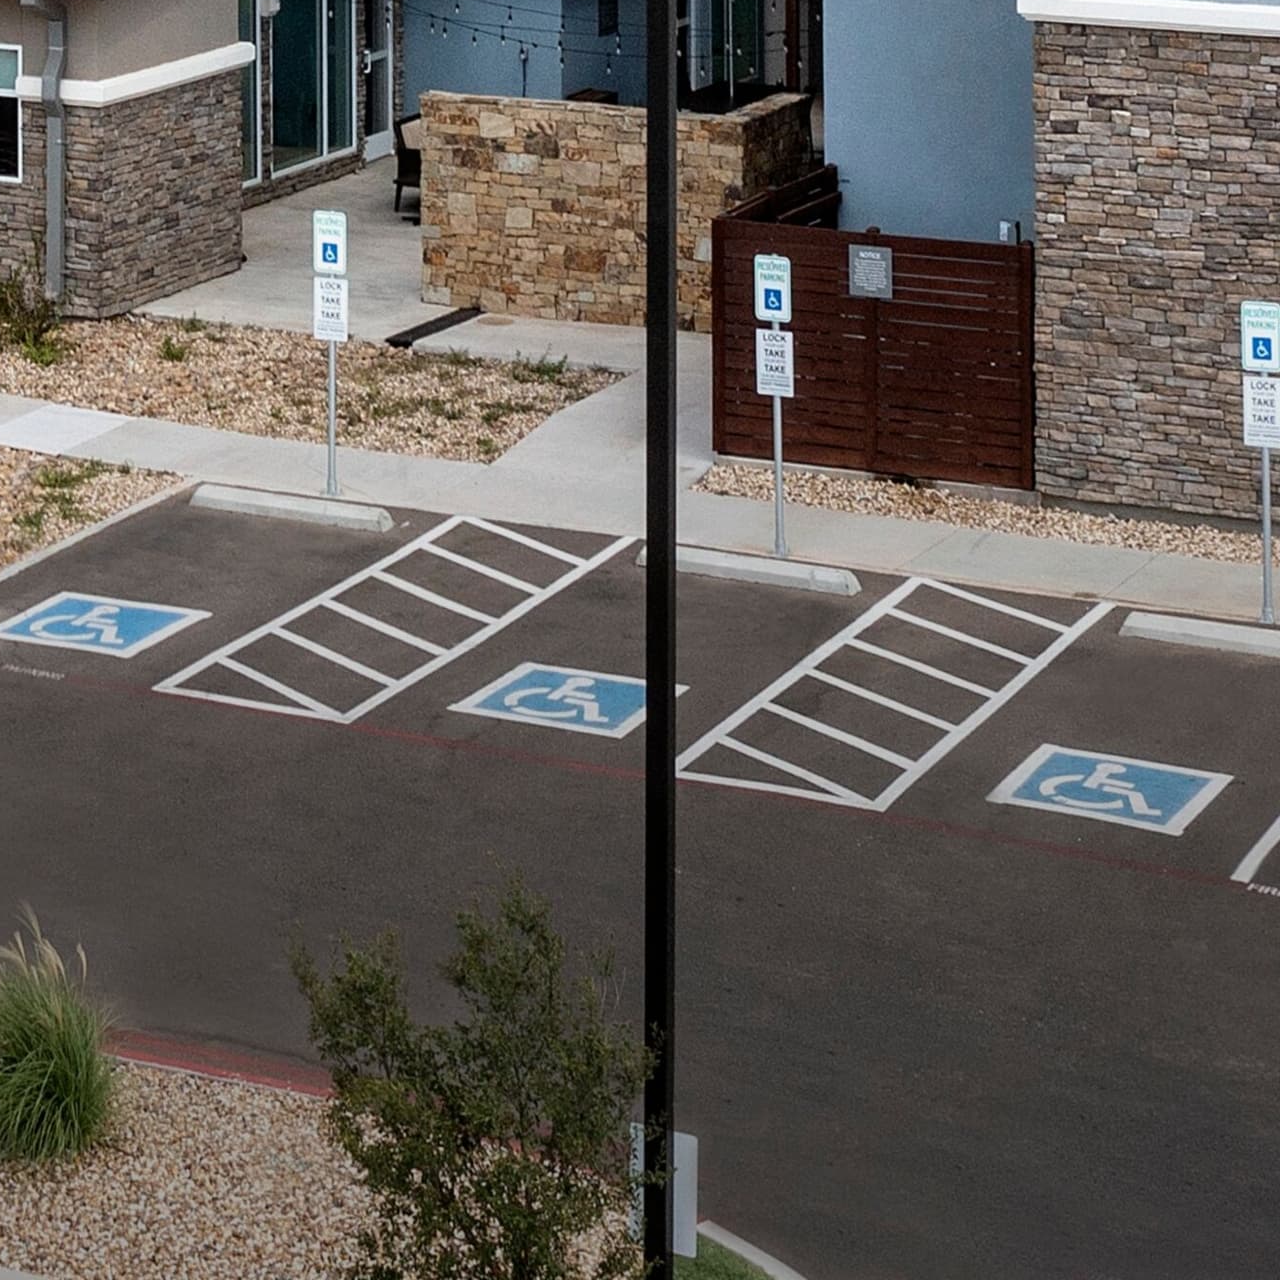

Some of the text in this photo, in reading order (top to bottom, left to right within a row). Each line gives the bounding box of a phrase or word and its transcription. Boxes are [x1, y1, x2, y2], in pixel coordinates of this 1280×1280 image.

[320, 281, 342, 291] LOCK
[321, 296, 341, 306] TAKE
[321, 310, 341, 320] TAKE
[762, 333, 787, 343] LOCK
[764, 348, 786, 359] TAKE
[764, 363, 786, 374] TAKE
[1250, 381, 1277, 391] LOCK
[1252, 397, 1276, 408] TAKE
[1252, 413, 1276, 424] TAKE
